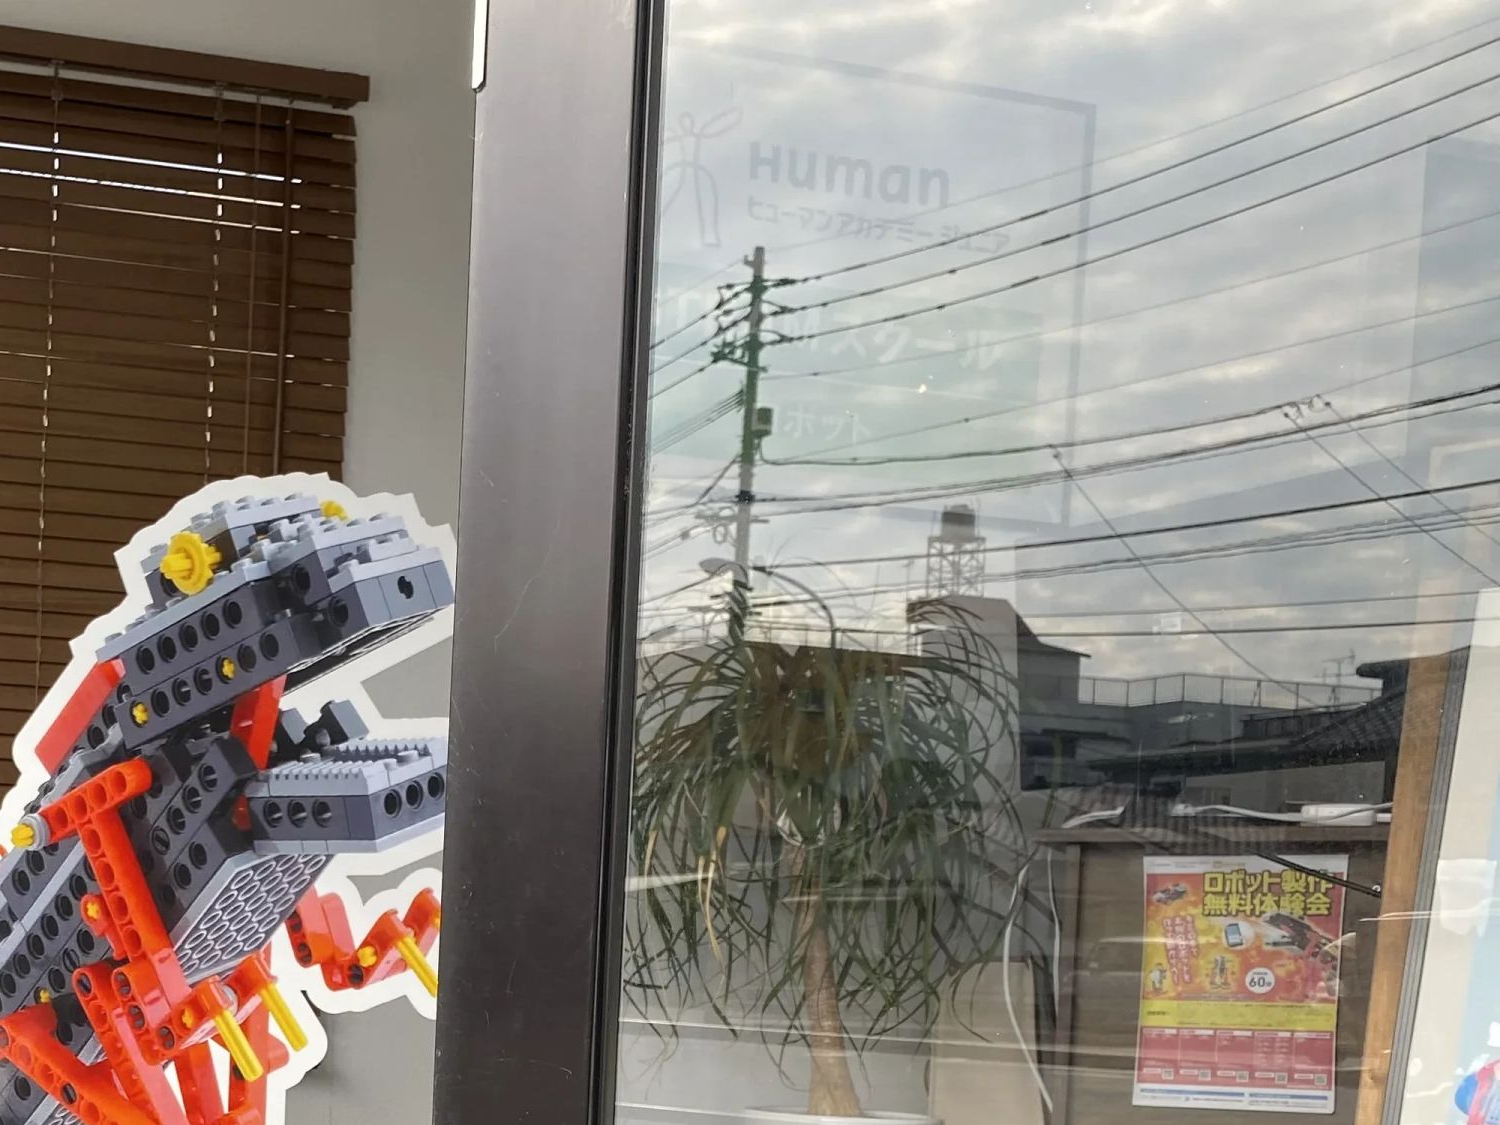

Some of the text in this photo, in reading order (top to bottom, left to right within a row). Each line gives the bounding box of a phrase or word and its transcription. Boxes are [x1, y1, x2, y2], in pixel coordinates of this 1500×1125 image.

[748, 140, 951, 207] Human
[1203, 893, 1332, 916] 無料体験会
